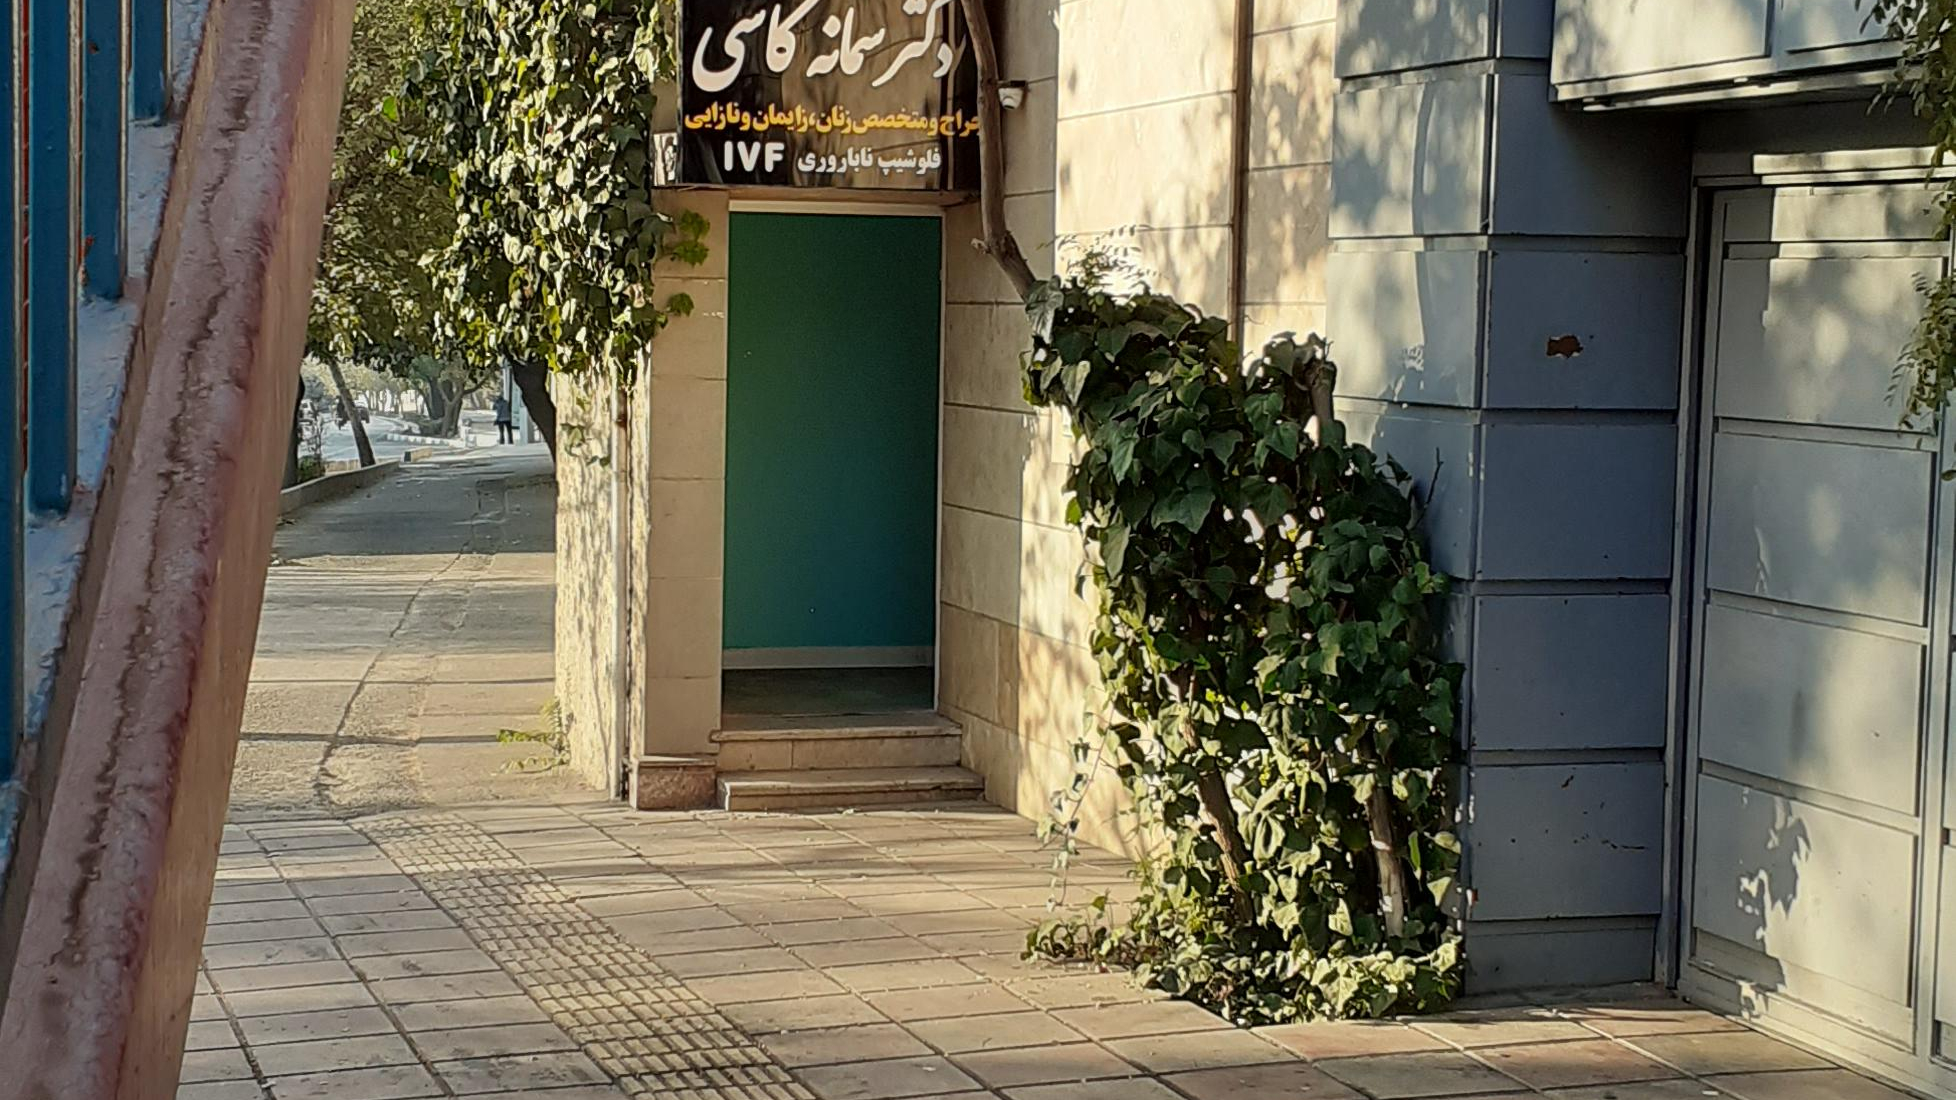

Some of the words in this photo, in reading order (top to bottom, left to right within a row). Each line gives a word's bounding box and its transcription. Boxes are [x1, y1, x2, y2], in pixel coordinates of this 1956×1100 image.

[806, 6, 886, 78] سمانه
[724, 140, 785, 173] IVF
[797, 146, 874, 173] ناباروری
[877, 148, 942, 175] فلوشیپ
